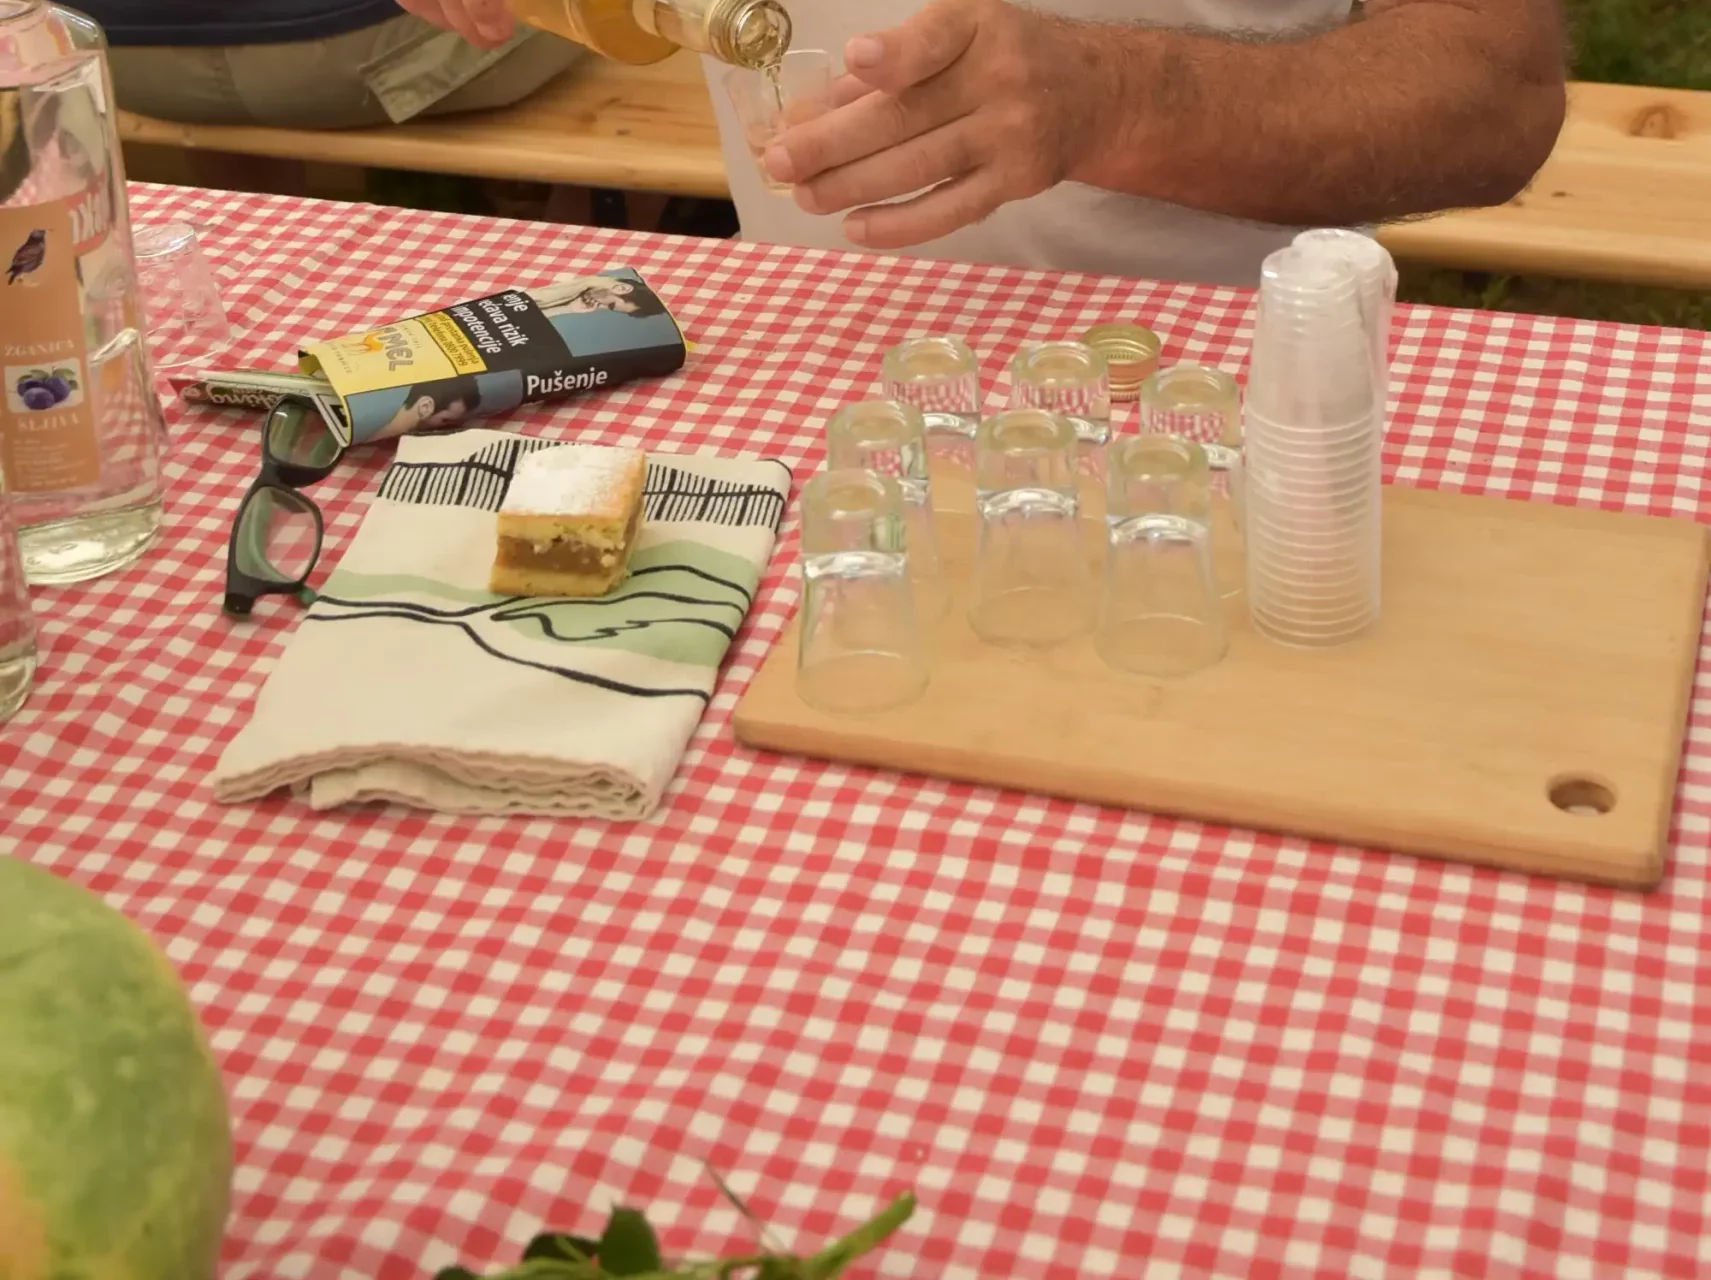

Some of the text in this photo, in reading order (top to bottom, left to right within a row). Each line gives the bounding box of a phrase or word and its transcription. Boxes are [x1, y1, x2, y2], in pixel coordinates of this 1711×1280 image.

[478, 298, 529, 347] ećava rizik
[503, 292, 529, 312] enje
[378, 327, 414, 372] AMEL
[450, 305, 501, 354] impotencije
[527, 367, 608, 396] Pušenje
